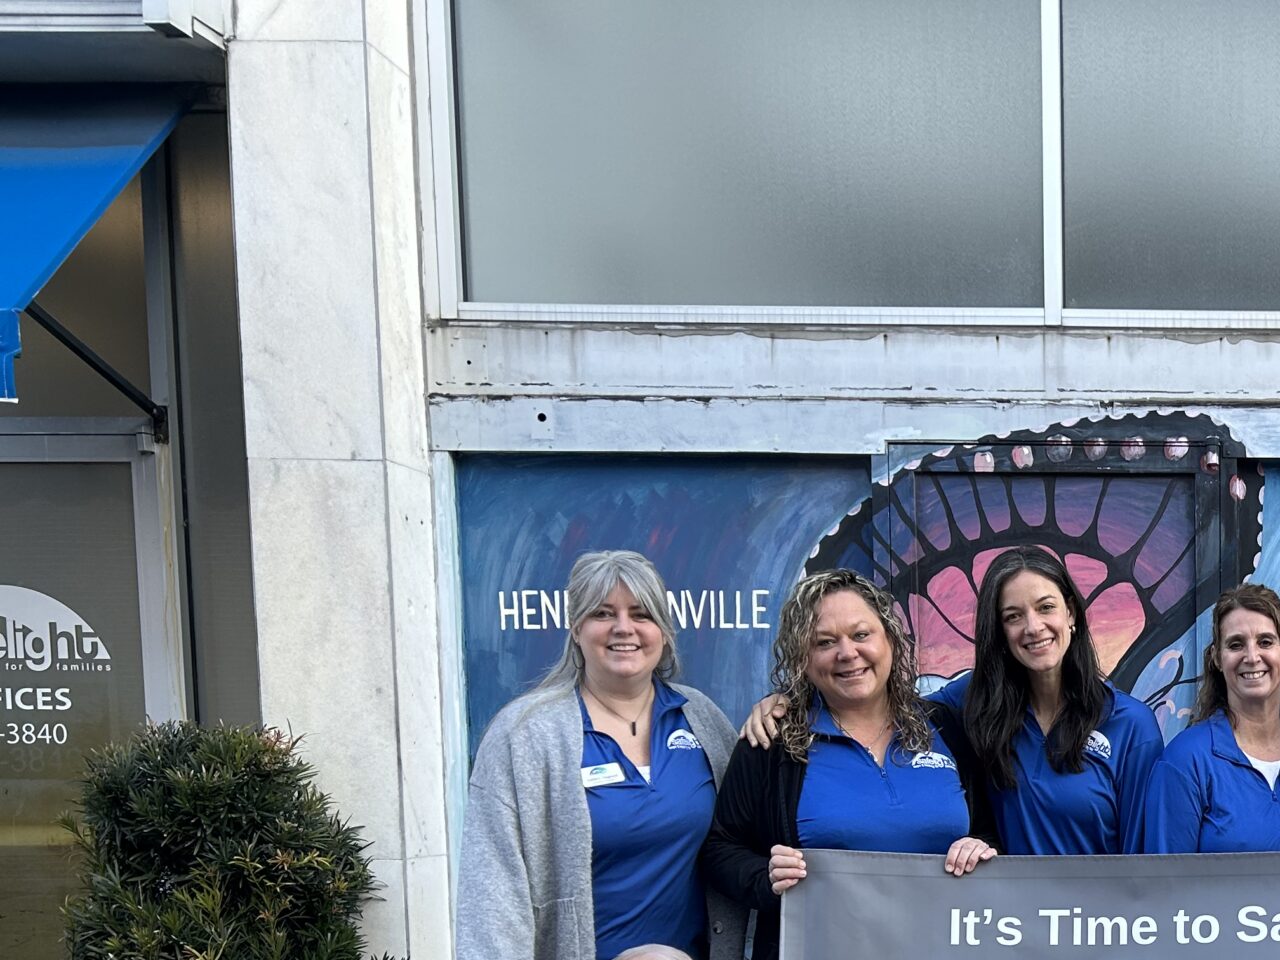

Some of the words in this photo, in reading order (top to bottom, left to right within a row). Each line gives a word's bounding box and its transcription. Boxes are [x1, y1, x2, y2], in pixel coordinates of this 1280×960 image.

[498, 589, 770, 630] HENNVILLE
[5, 662, 23, 671] for
[56, 662, 112, 671] families
[0, 687, 72, 711] ICES
[949, 907, 1023, 946] It's
[1038, 907, 1159, 946] Time
[1172, 909, 1220, 944] to
